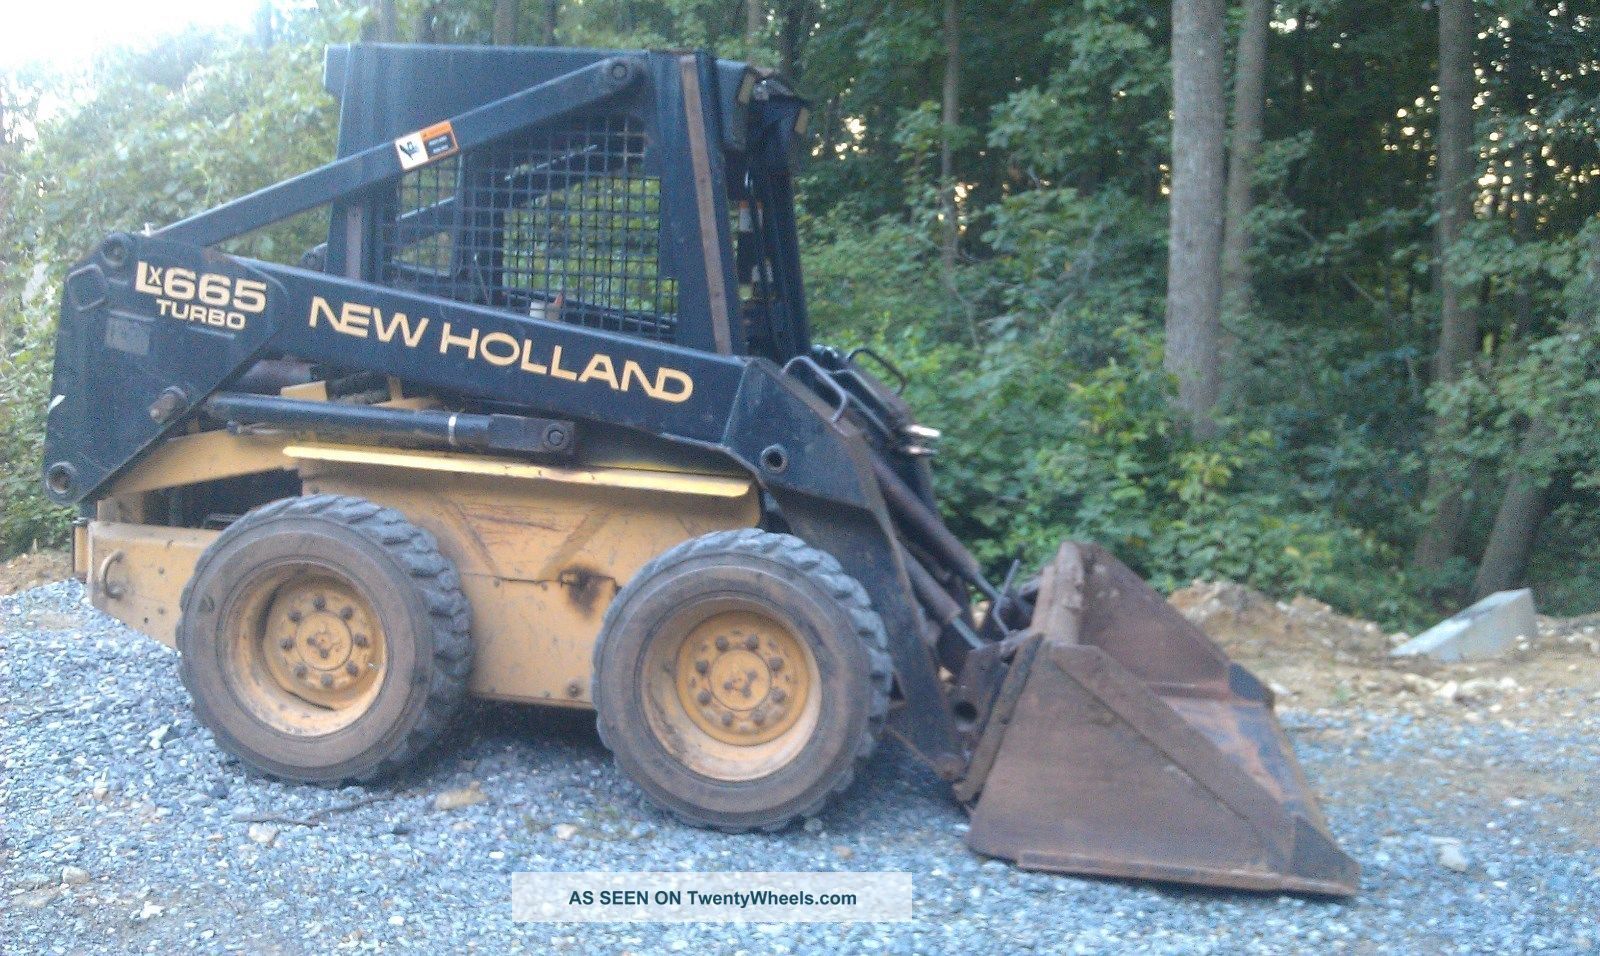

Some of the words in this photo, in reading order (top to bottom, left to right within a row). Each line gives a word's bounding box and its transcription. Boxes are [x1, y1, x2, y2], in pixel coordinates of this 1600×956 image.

[156, 299, 246, 330] TURBO
[308, 296, 429, 348] NEW
[439, 322, 694, 404] HOLLAND
